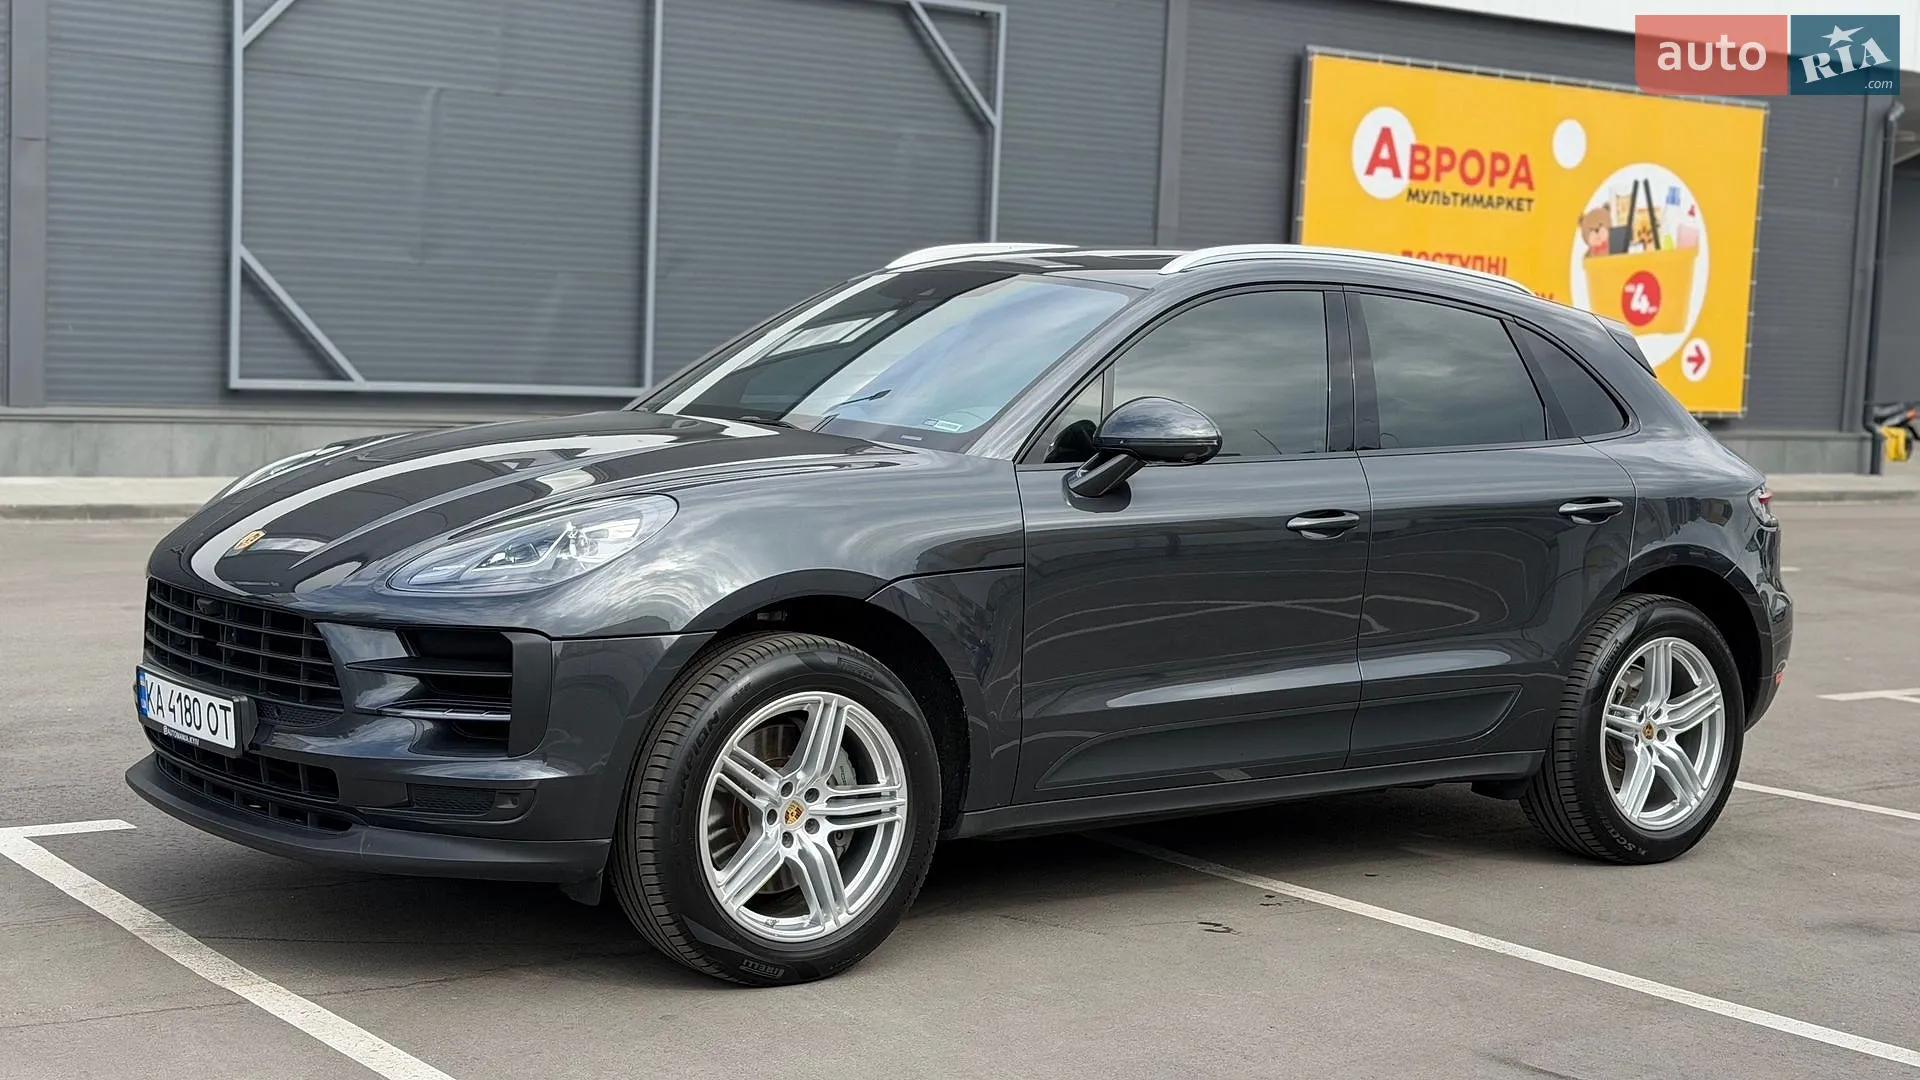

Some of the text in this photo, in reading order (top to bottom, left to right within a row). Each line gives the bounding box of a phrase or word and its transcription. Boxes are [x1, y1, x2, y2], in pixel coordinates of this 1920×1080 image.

[1364, 126, 1536, 191] АВРОРА
[1406, 188, 1535, 213] МУЛЬТИМАРКЕТ
[146, 680, 165, 718] KA
[168, 689, 202, 731] 4180
[206, 701, 232, 740] OT
